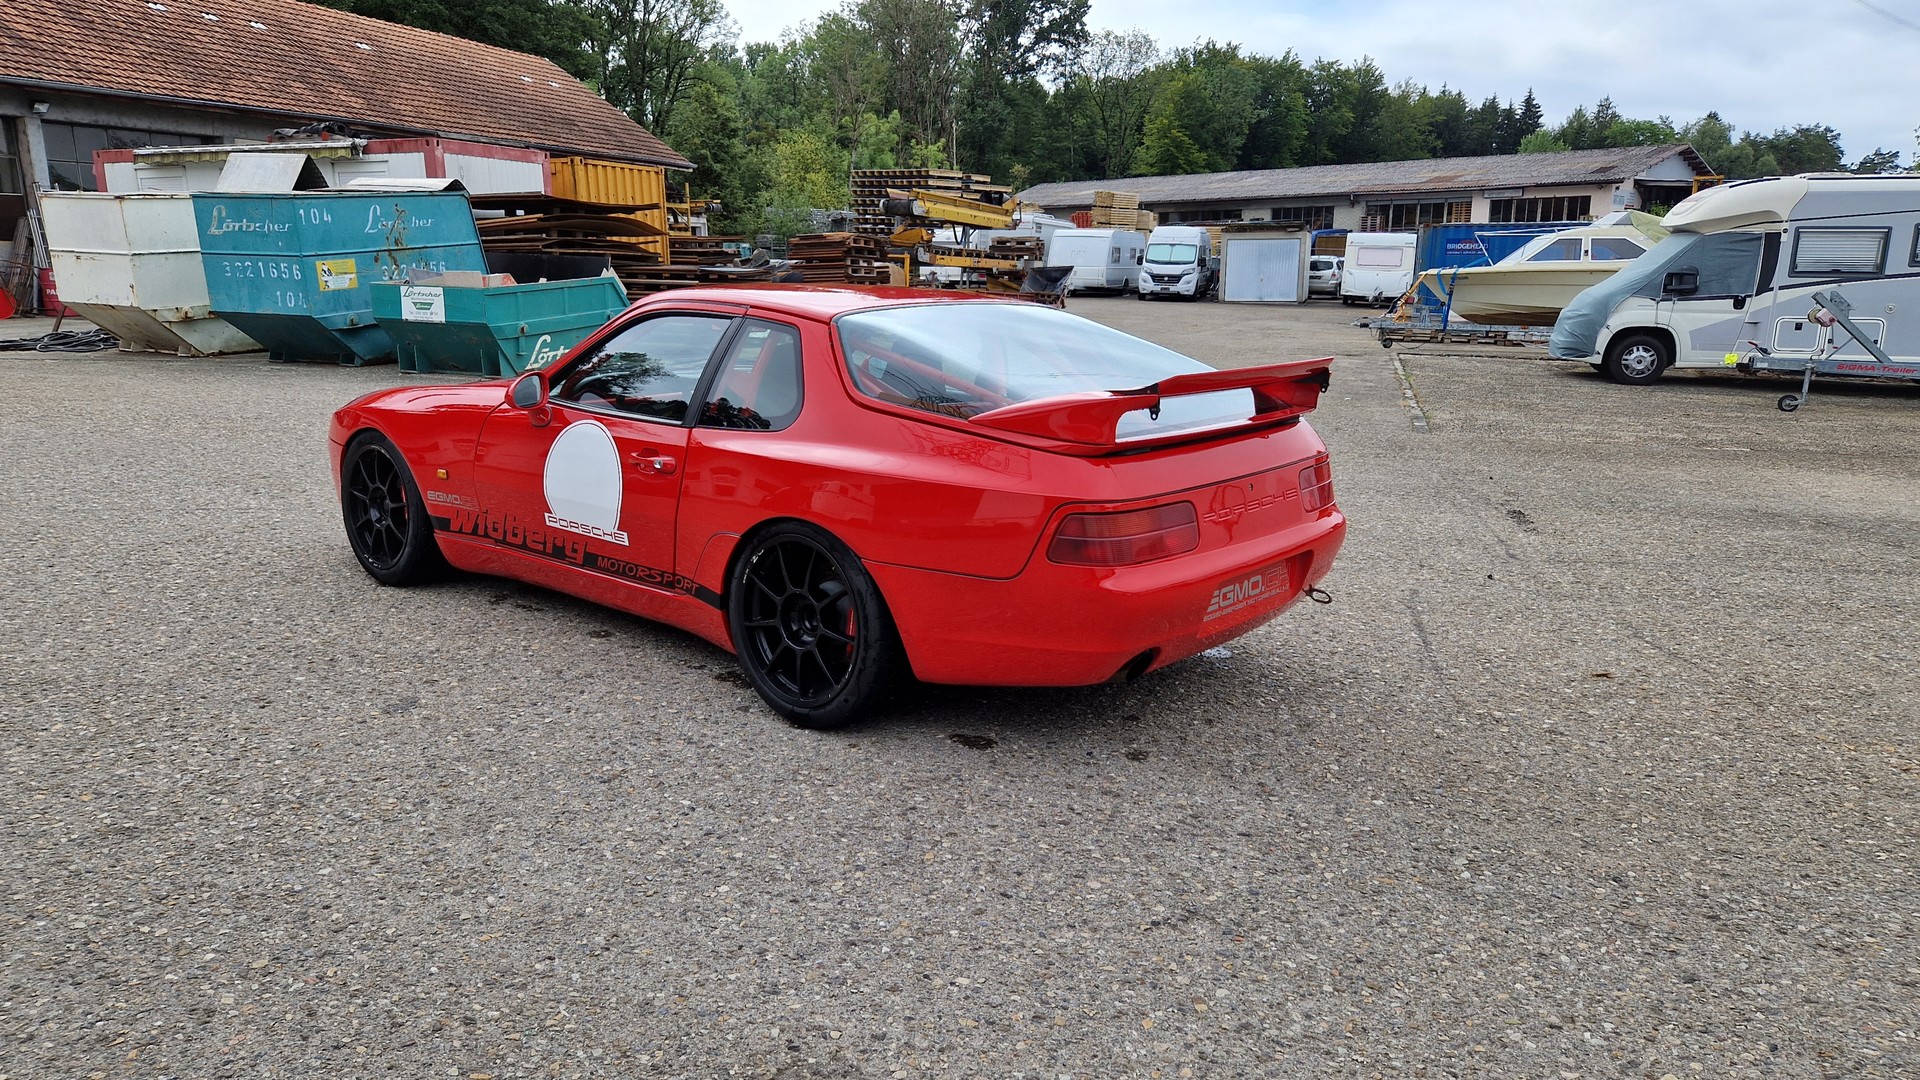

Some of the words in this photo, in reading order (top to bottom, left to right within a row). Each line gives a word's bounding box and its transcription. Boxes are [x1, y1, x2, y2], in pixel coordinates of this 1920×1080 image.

[299, 208, 332, 225] 104
[222, 261, 301, 280] 3221656
[1203, 488, 1298, 525] PORSCHE
[547, 515, 626, 543] PORSCHE
[450, 509, 588, 565] Widberg
[597, 556, 700, 595] MOTORSPORT
